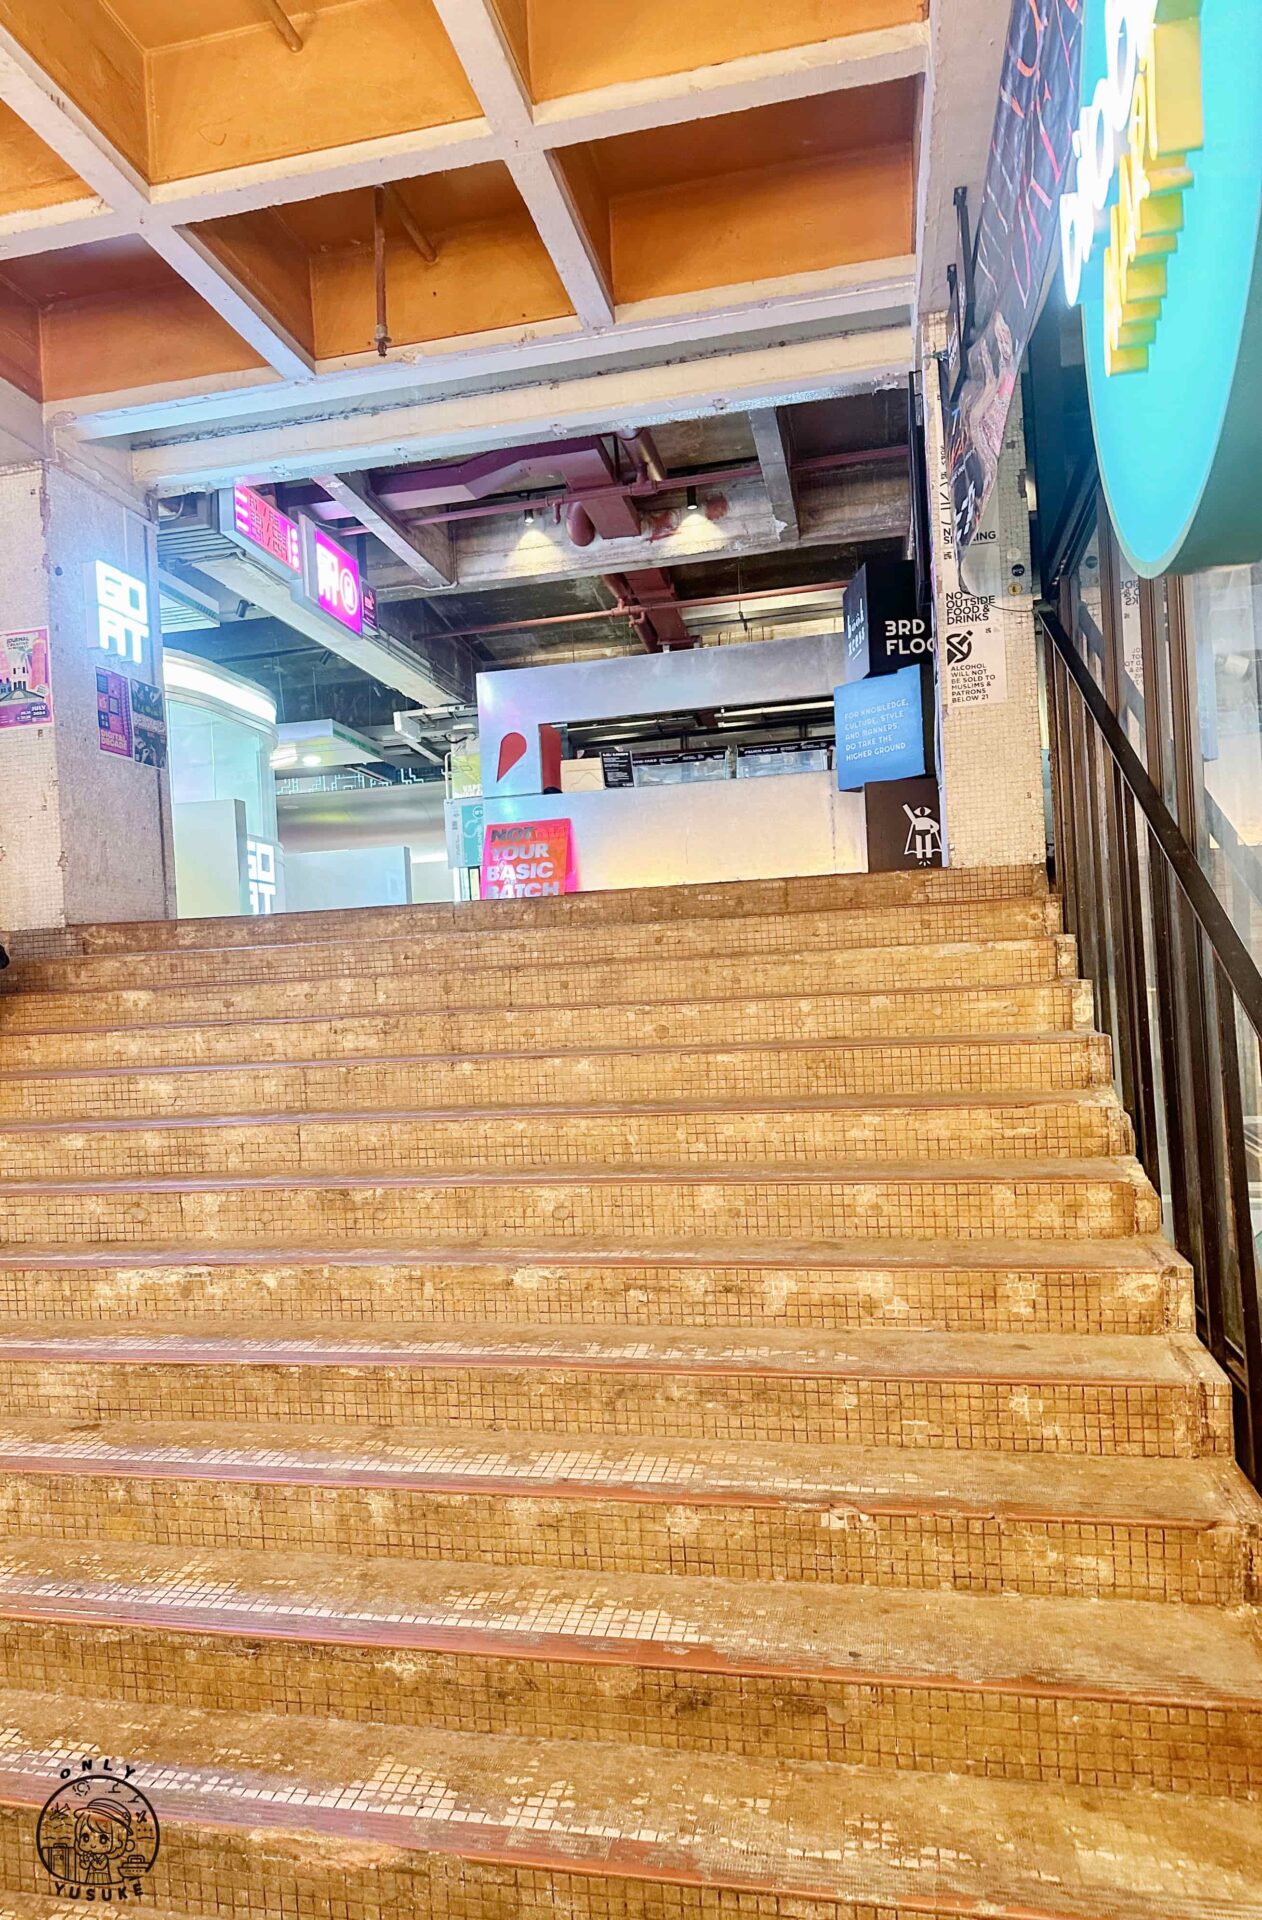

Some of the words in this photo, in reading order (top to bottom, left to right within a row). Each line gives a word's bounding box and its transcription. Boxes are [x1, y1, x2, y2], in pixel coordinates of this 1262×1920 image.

[946, 591, 963, 601] NO
[946, 595, 996, 609] OUTSIDE
[946, 606, 980, 617] FOOD
[982, 604, 990, 613] &
[946, 613, 989, 625] DRINKS
[885, 619, 925, 637] 3RD
[951, 663, 986, 672] ALCOHOL
[951, 682, 984, 691] MUSLIMS
[951, 688, 986, 697] PATRONS
[952, 695, 979, 704] BELOW
[844, 711, 860, 720] FOR
[881, 710, 905, 722] STYLE
[845, 732, 860, 740] AND
[845, 742, 856, 751] DO
[858, 738, 877, 748] TAKE
[879, 734, 893, 743] THE
[846, 749, 873, 761] HIGHER
[874, 742, 906, 755] GROUND
[491, 826, 535, 843] NOT
[492, 843, 550, 861] YOUR
[486, 861, 554, 882] BASIC
[486, 881, 559, 899] BATCH
